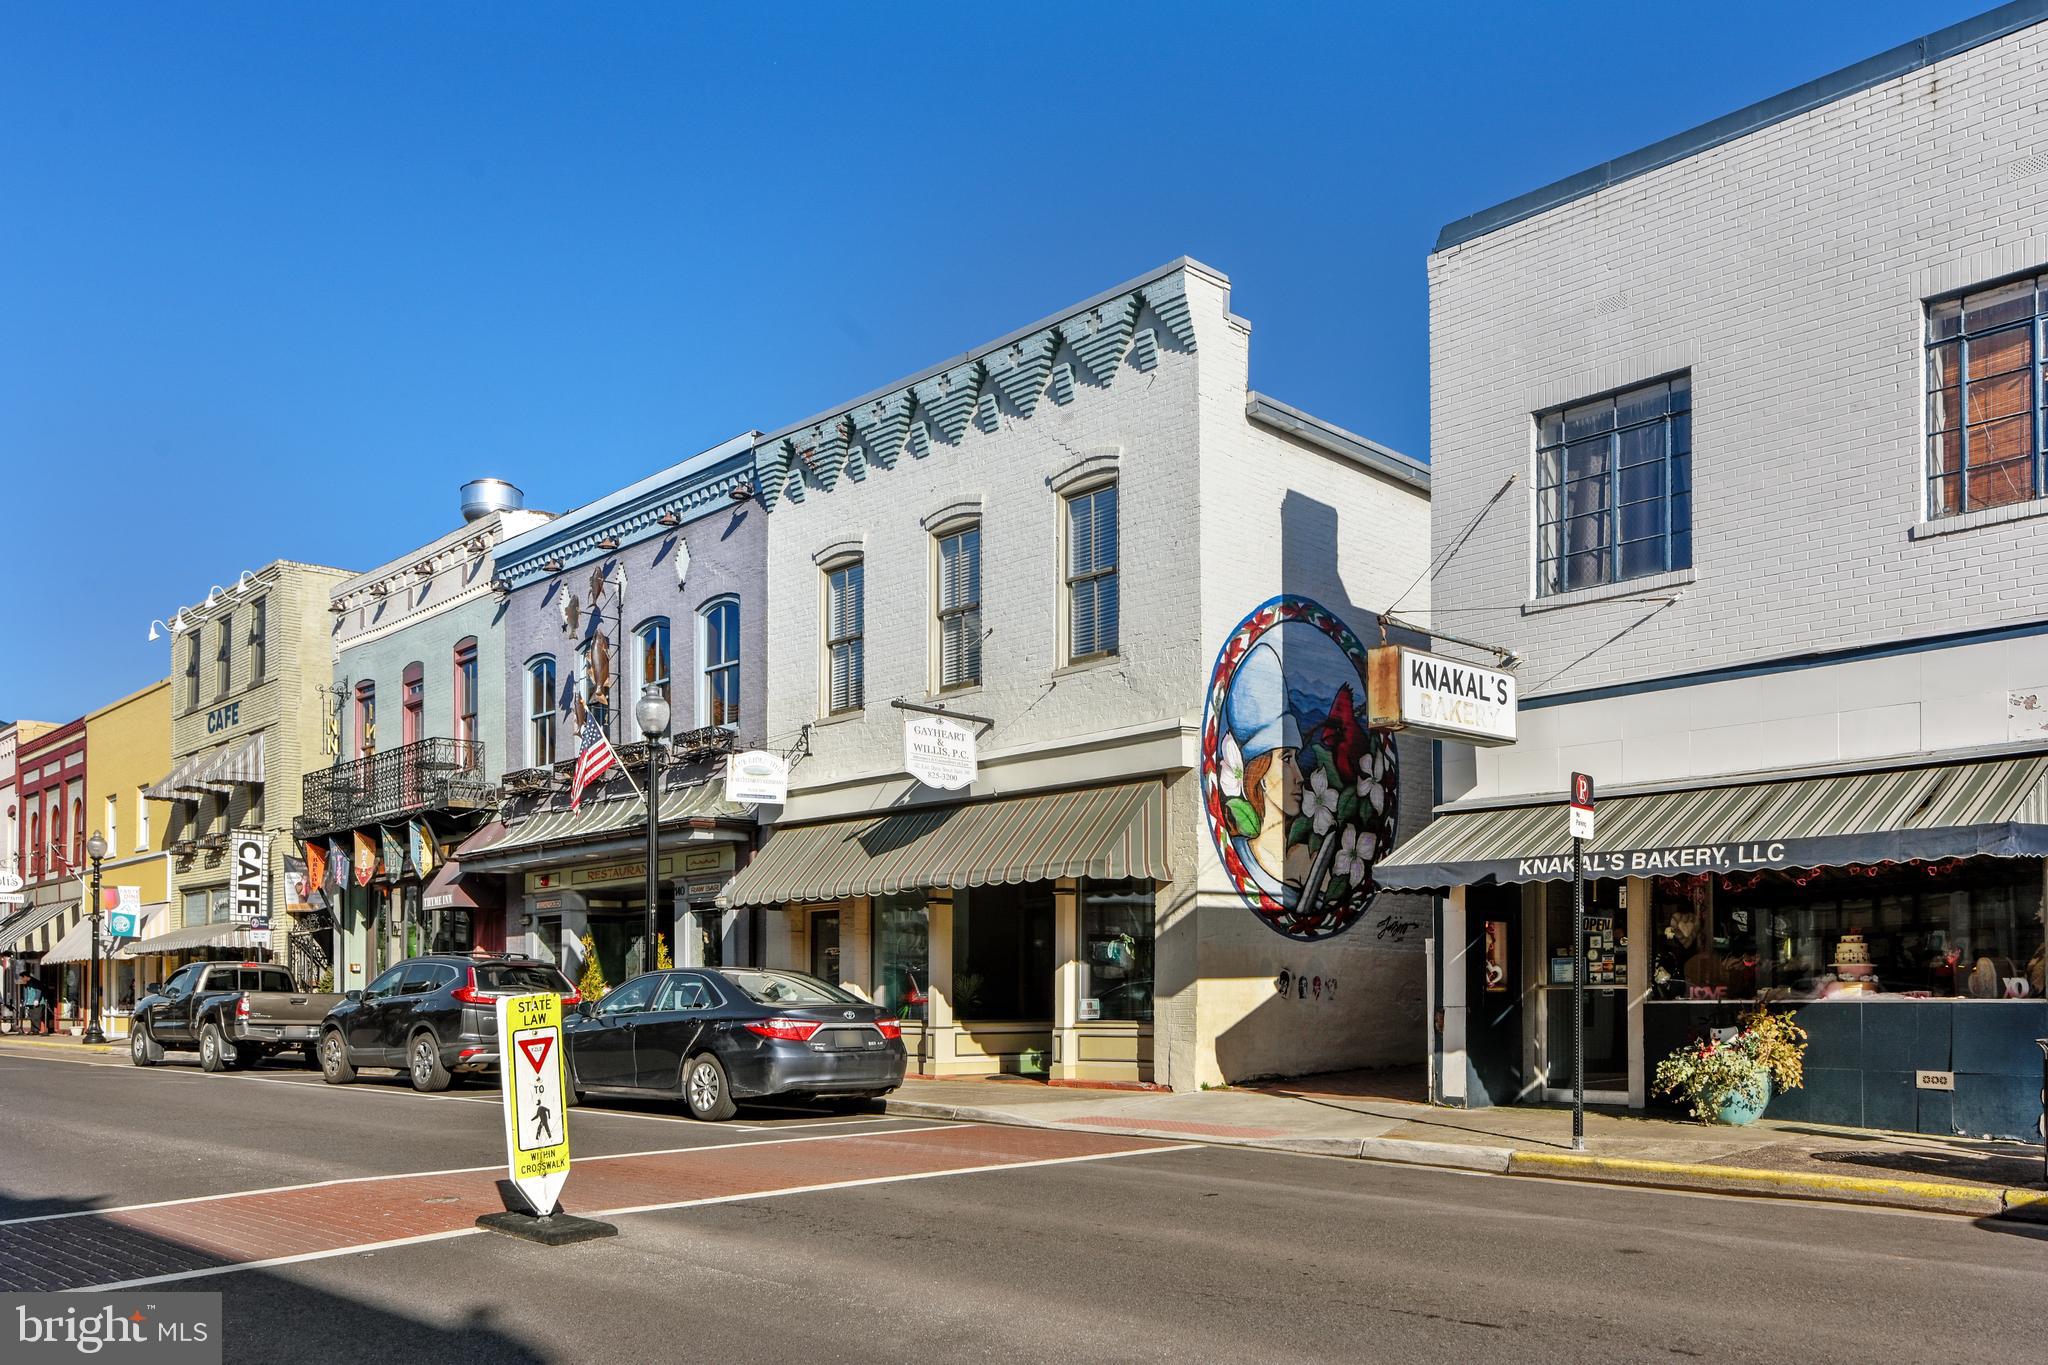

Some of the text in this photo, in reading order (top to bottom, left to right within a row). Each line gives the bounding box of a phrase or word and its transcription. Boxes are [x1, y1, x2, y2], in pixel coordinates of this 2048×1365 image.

[1411, 659, 1508, 706] KNAKAL'S
[207, 702, 239, 734] CAFE
[326, 699, 339, 755] INN
[914, 725, 966, 742] GAYHEART
[937, 738, 944, 746] &
[913, 743, 969, 759] WILLIS, P.C.
[928, 771, 958, 781] 825-3200
[1580, 780, 1587, 799] P
[1519, 843, 1785, 876] KNAKAL'S BAKERY, LLC
[238, 842, 262, 914] CAFE
[587, 864, 648, 881] RESTAURAN
[1583, 918, 1611, 930] OPEN
[2002, 978, 2030, 998] XO
[518, 999, 551, 1013] STATE
[524, 1012, 547, 1026] LAW
[534, 1085, 545, 1094] TO
[530, 1149, 556, 1161] WITHIN
[520, 1158, 565, 1175] CROSSWALK
